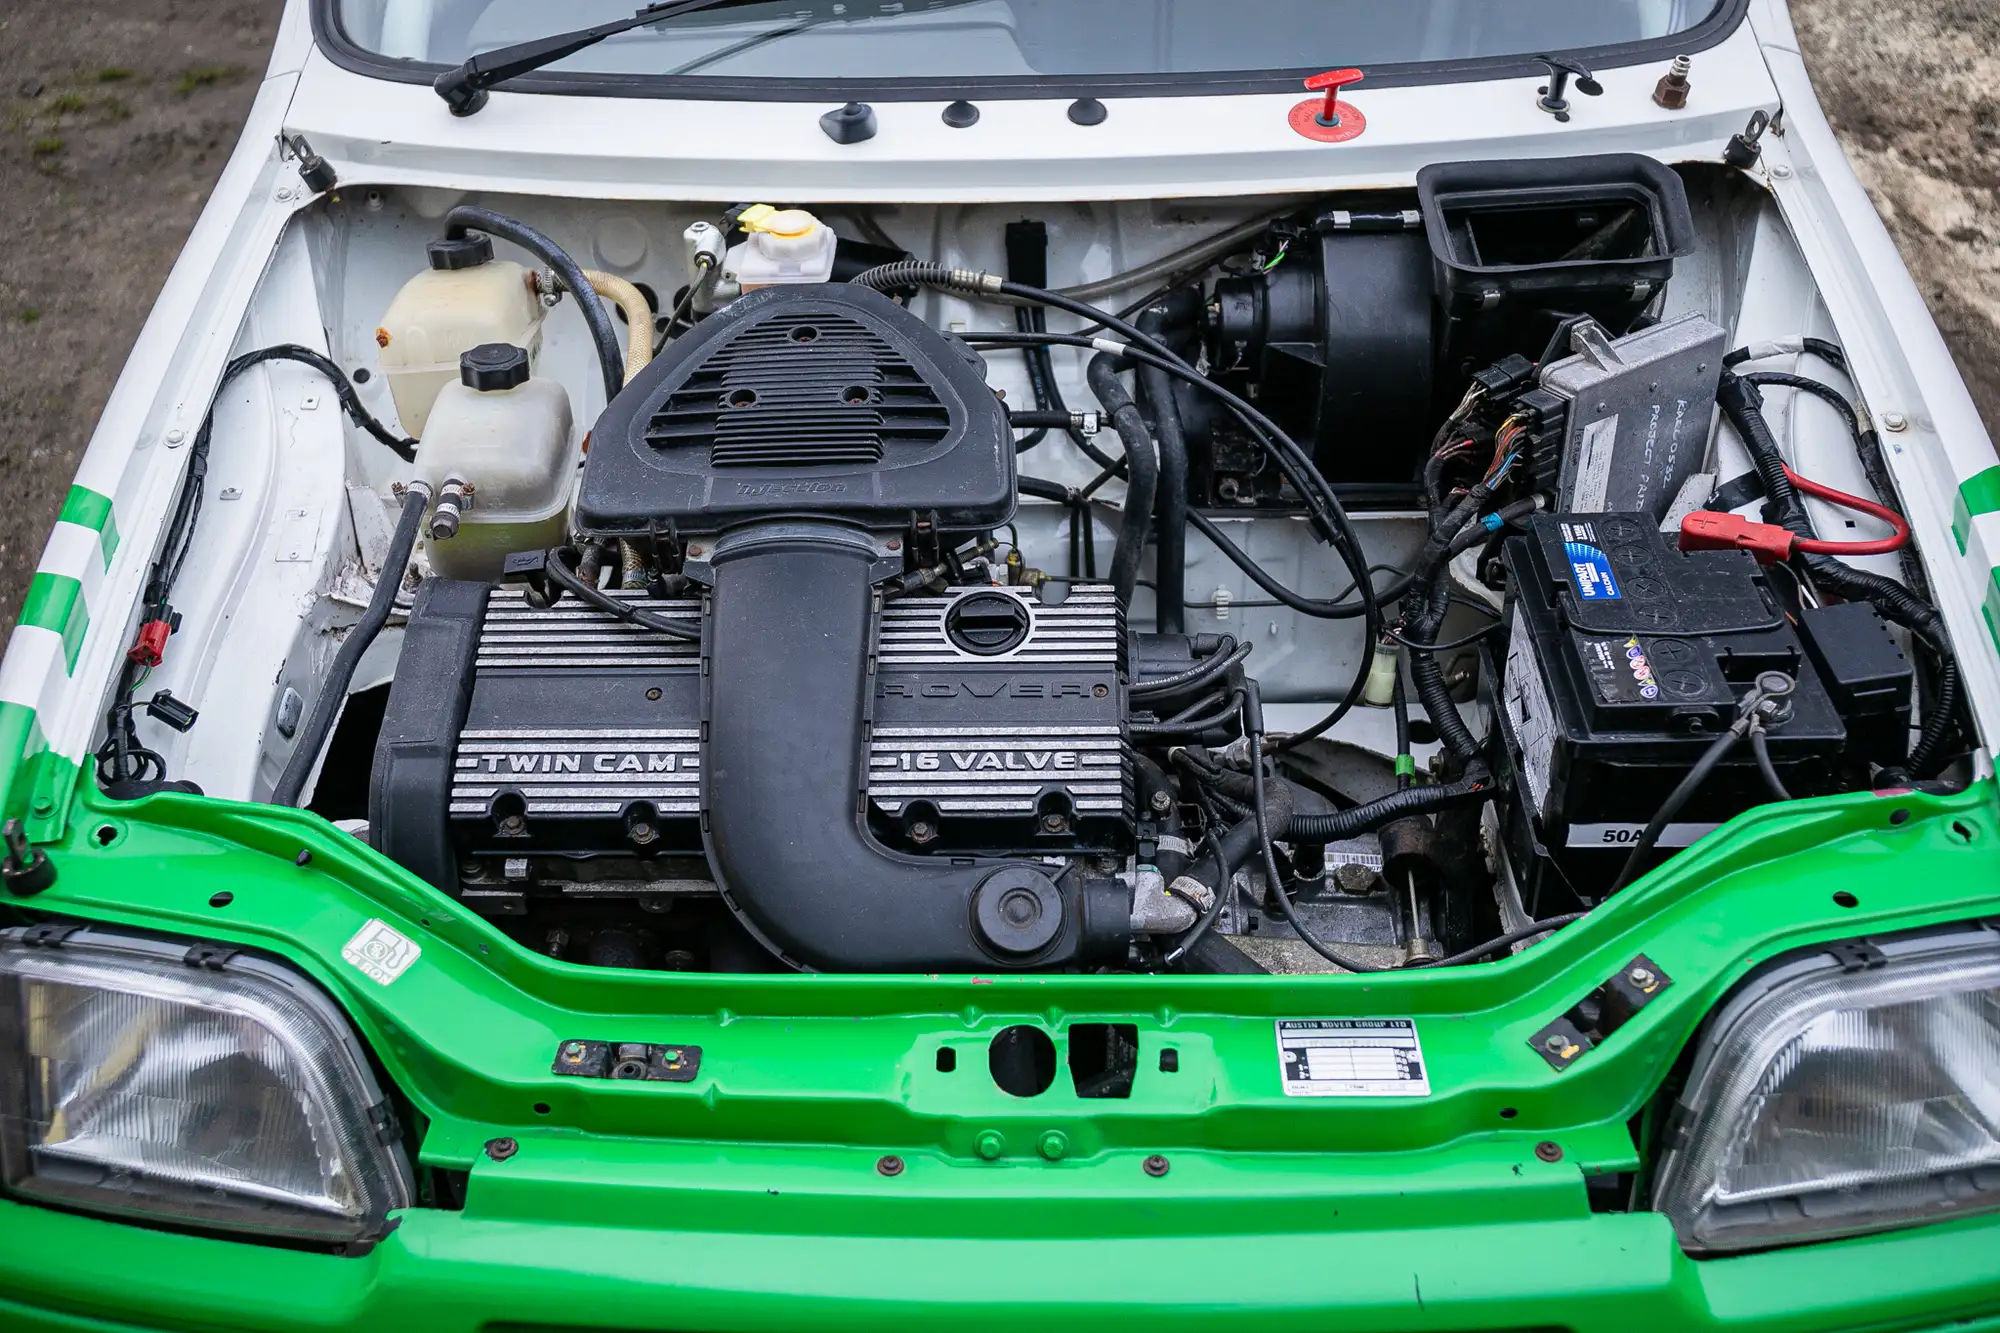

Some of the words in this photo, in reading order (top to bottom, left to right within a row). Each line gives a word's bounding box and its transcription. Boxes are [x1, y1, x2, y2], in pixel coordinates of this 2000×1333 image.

[1643, 404, 1660, 465] PROJECT
[1573, 562, 1596, 597] UNIPART
[1600, 572, 1615, 596] CALCIUM
[876, 682, 1090, 698] ROVER
[482, 754, 581, 773] TWIN
[593, 754, 676, 773] CAM
[900, 752, 940, 770] 16
[950, 752, 1077, 770] VALVE
[1602, 830, 1659, 842] 50A
[1285, 1021, 1318, 1029] AUSTIN
